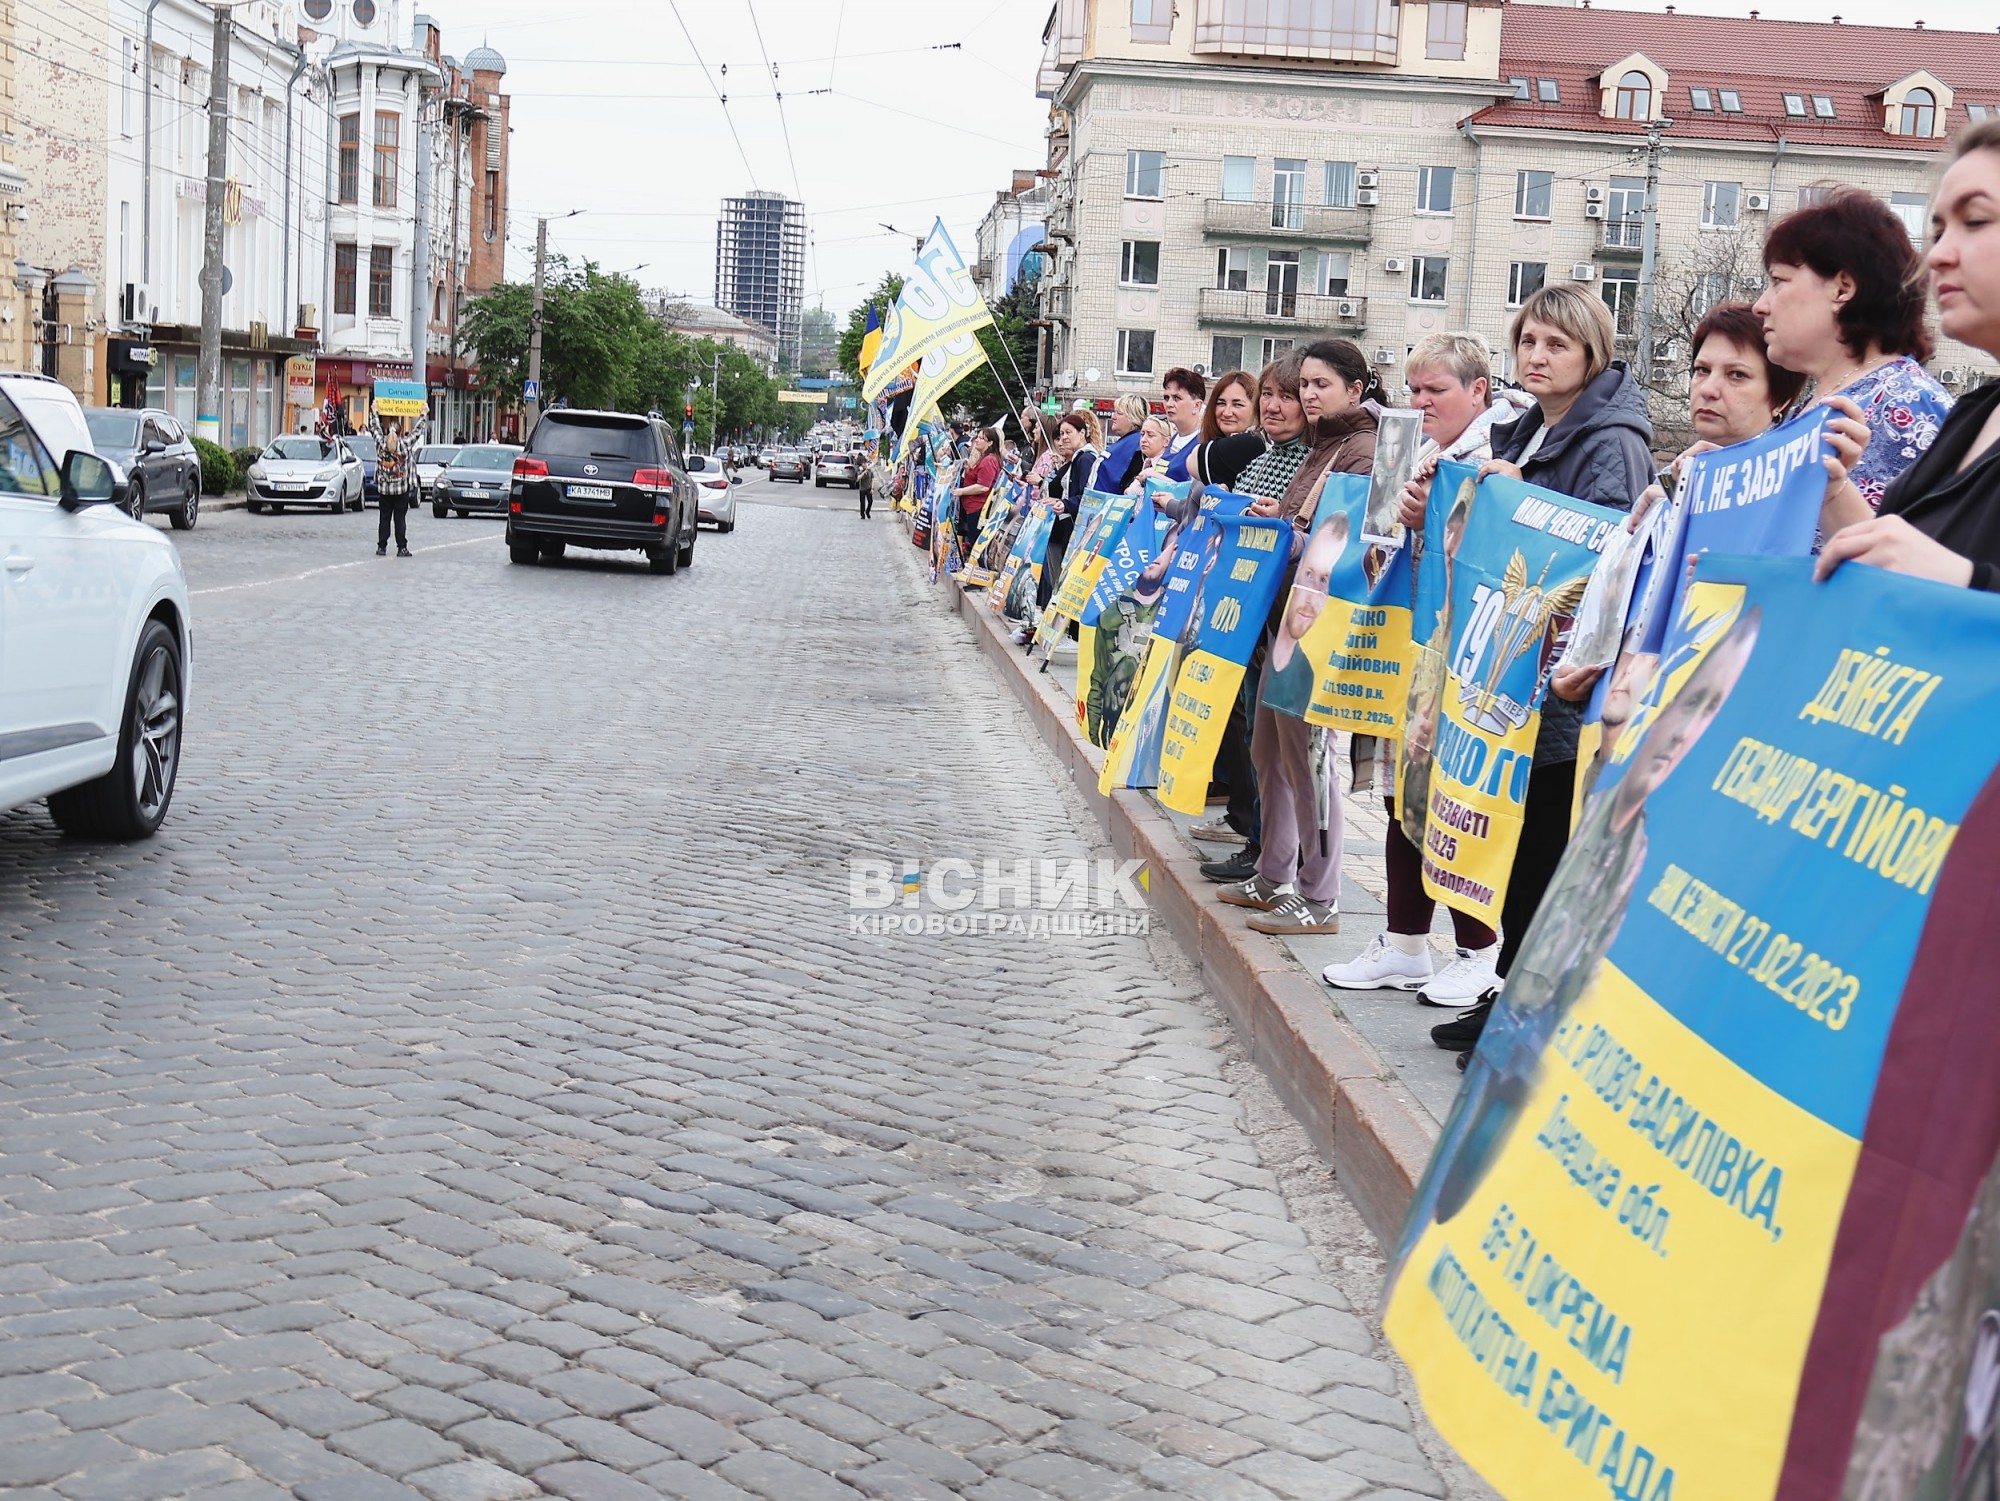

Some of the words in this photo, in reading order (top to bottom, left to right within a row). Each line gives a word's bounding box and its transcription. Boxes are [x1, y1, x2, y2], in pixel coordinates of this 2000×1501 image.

[388, 388, 413, 396] Сигнал
[1708, 463, 1738, 513] НЕ
[1737, 421, 1823, 507] ЗАБУТИ
[1511, 495, 1560, 532] МАМА
[1547, 507, 1599, 546] ЧЕКАЄ
[1453, 583, 1505, 677] 79
[1726, 915, 1860, 1031] 27.02.2023
[1537, 1367, 1674, 1501] БРИГАДА
